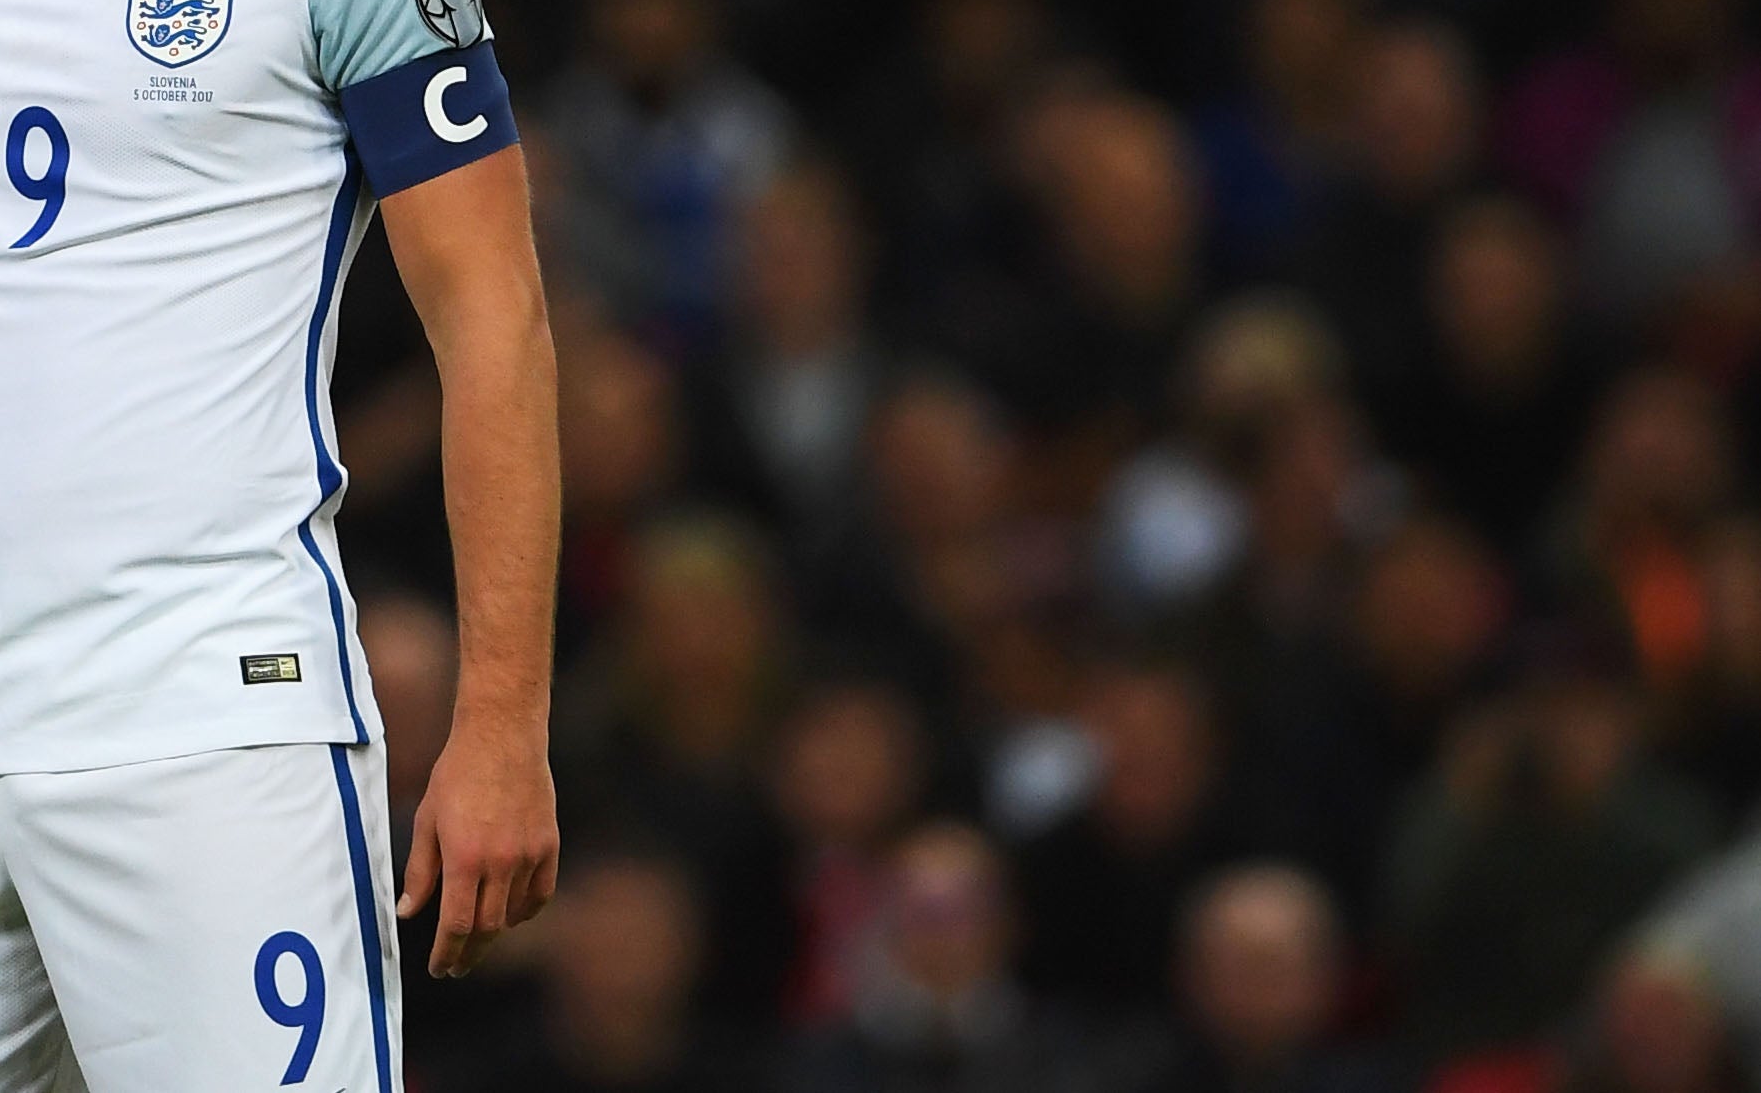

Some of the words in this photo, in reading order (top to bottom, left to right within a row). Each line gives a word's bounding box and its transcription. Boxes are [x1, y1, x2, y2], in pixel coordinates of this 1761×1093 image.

[133, 89, 140, 101] 5
[142, 90, 188, 102] OCTOBER
[191, 91, 213, 103] 2017
[149, 76, 197, 89] SLOVENIA
[423, 66, 489, 143] C
[5, 105, 71, 249] 9
[254, 930, 326, 1087] 9
